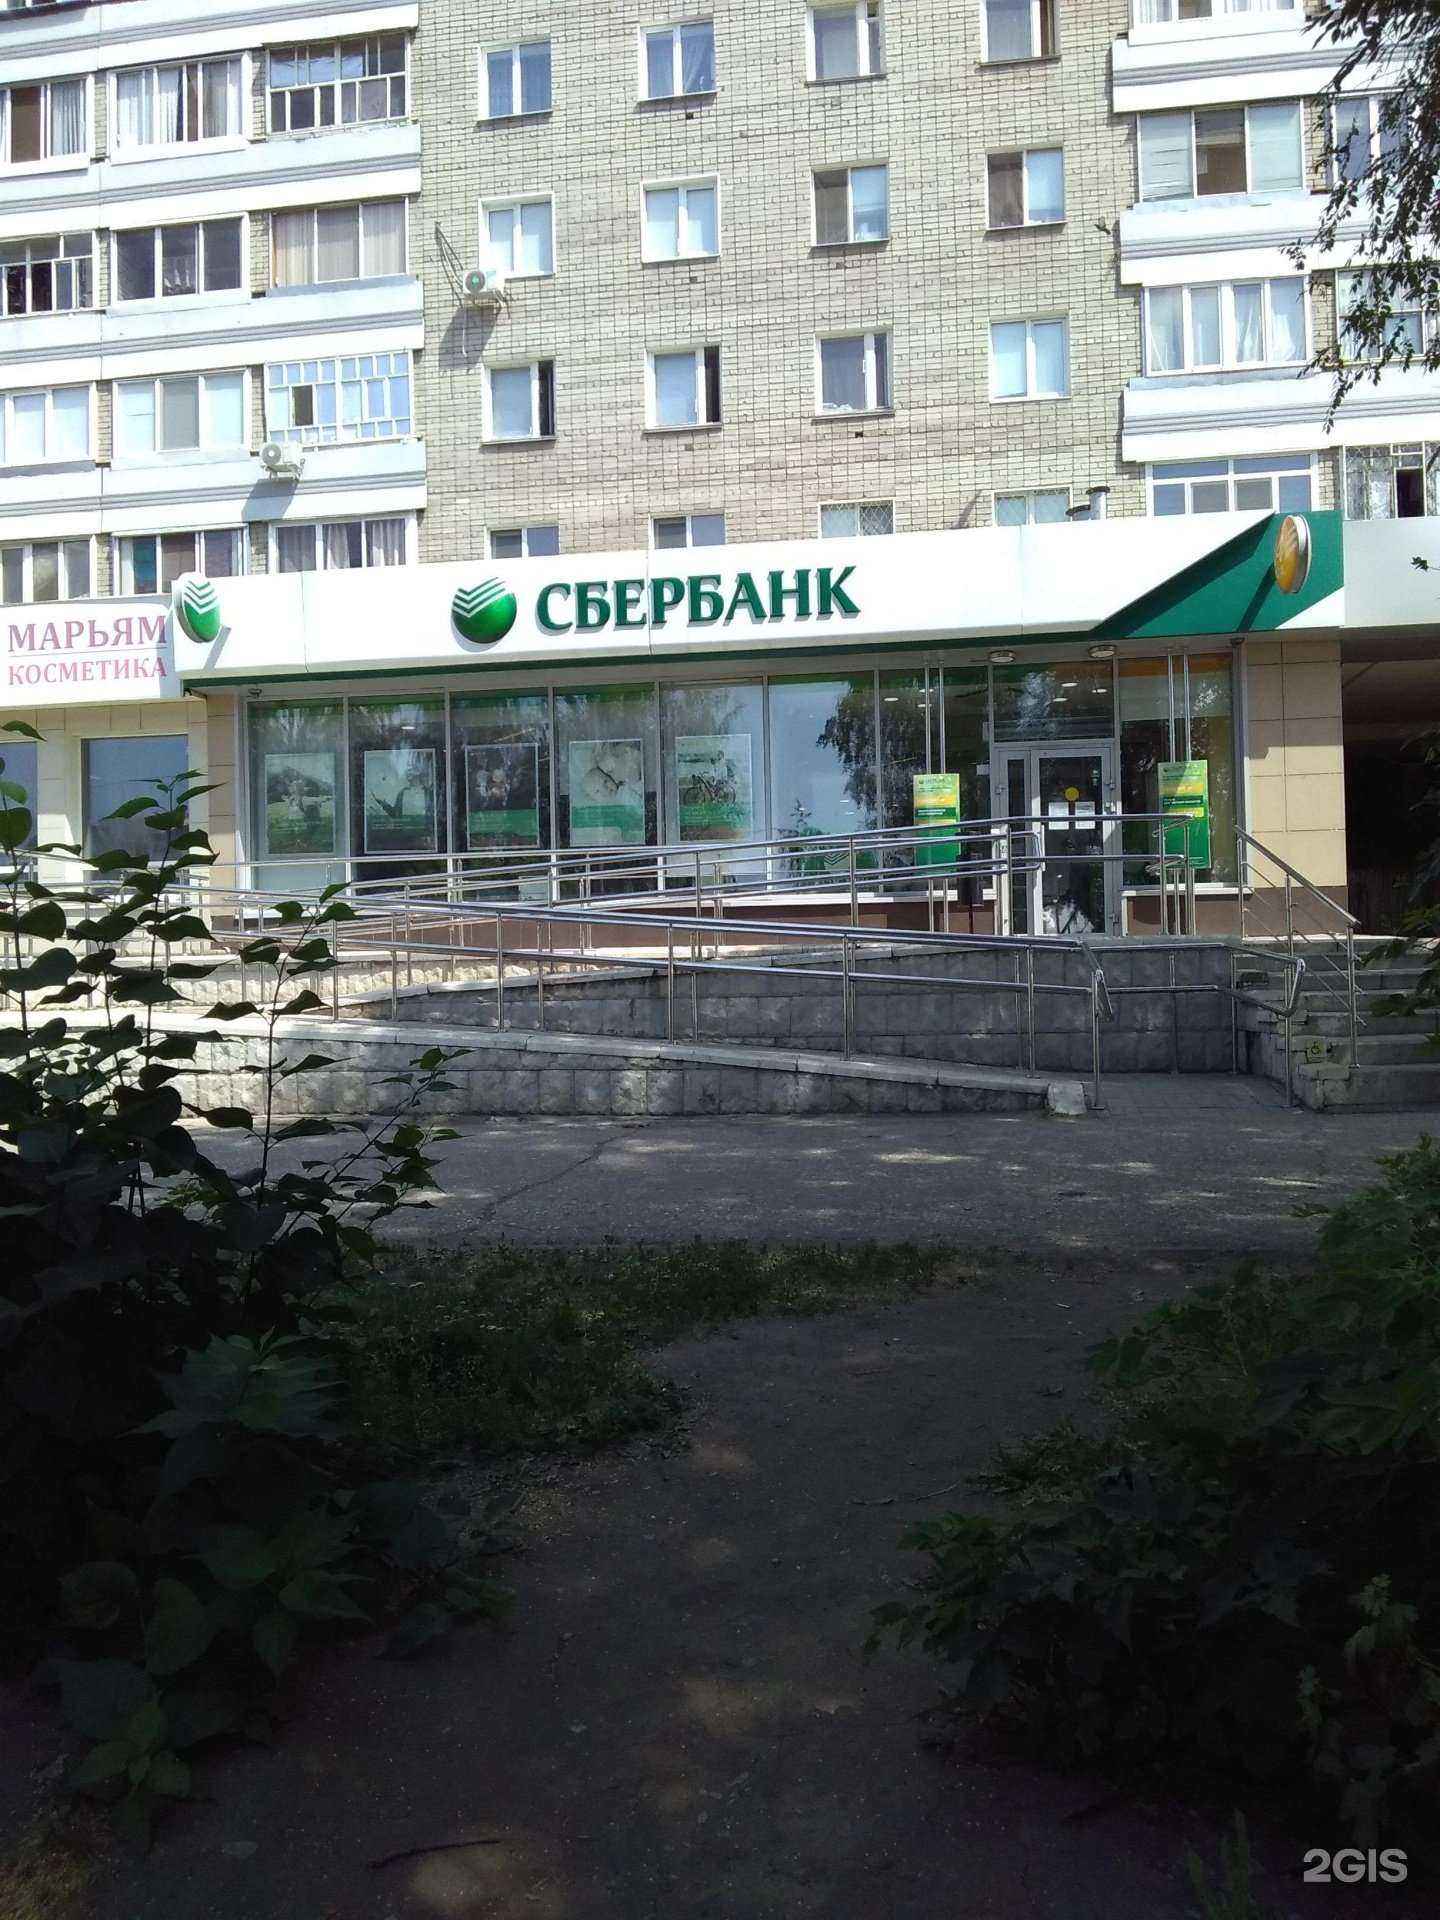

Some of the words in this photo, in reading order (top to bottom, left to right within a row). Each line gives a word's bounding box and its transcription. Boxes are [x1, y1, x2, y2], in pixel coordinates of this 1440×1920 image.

[538, 566, 861, 630] СБЕРБАНК
[8, 615, 168, 652] МАРЬЯМ
[8, 657, 168, 685] КОСМЕТИКА
